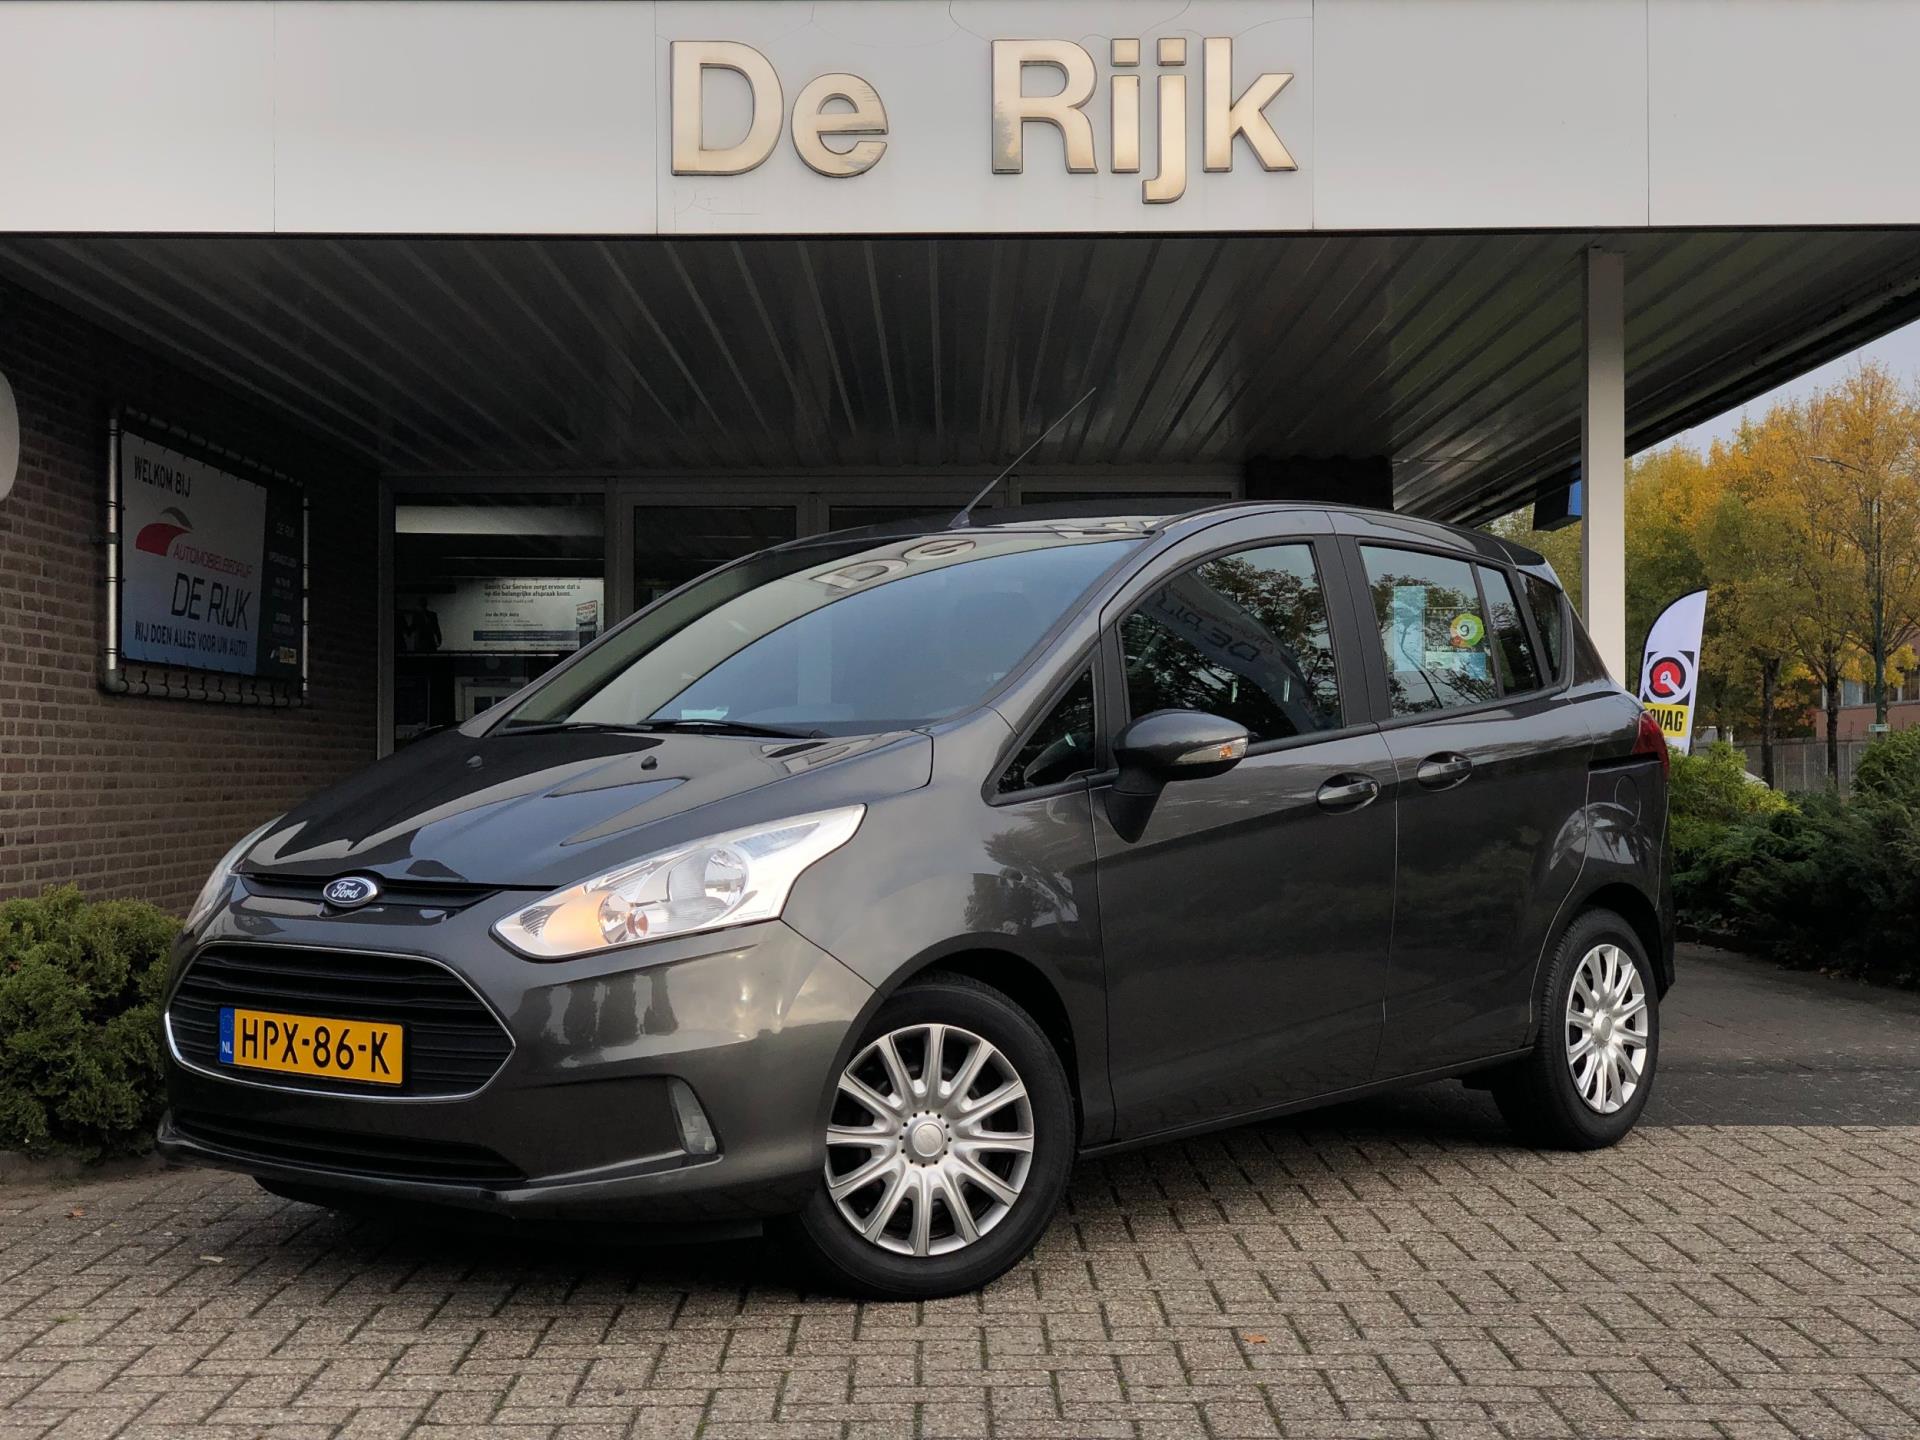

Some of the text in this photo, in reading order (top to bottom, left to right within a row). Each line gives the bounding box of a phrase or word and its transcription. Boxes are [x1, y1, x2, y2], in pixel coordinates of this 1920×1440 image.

[670, 37, 1298, 204] De Rijk
[134, 456, 191, 497] WELKOM BIJ
[171, 572, 252, 631] DE RIJK
[134, 620, 148, 643] WIJ
[150, 624, 172, 646] DOEN
[173, 628, 196, 650] ALLES
[197, 632, 216, 653] VOOR
[217, 638, 228, 655] UW
[331, 881, 362, 899] Ford
[221, 1018, 391, 1075] NL HPX-86-K
